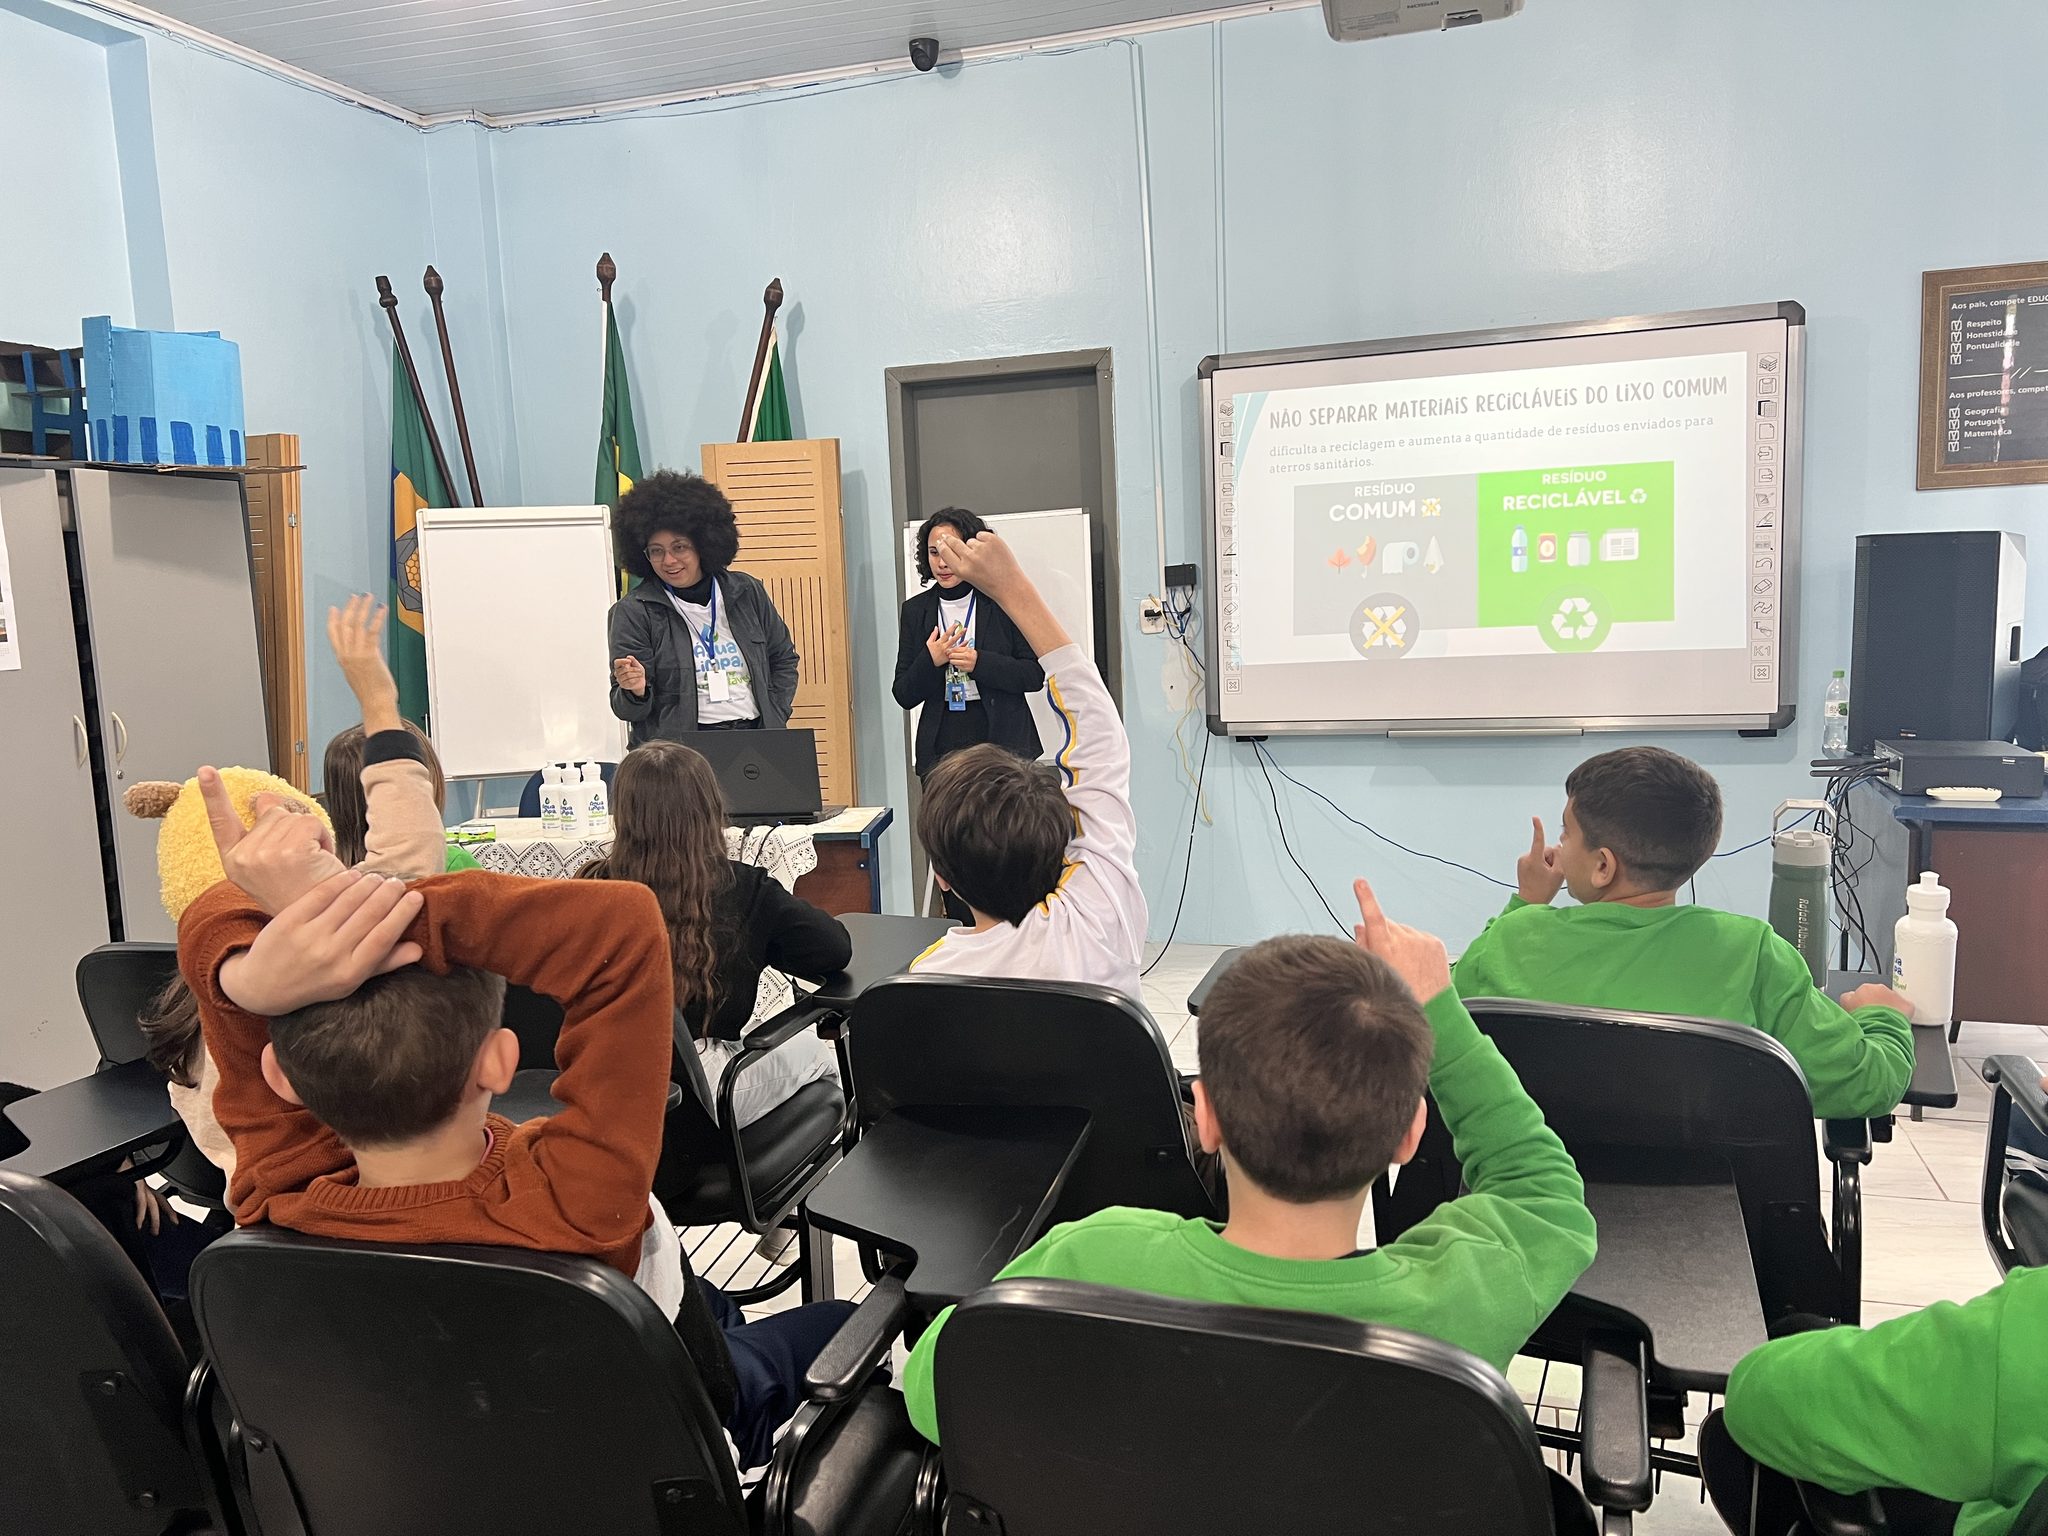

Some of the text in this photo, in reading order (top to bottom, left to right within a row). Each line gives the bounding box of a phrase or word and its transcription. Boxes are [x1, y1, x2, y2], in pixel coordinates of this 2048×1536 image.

[1969, 300, 1988, 309] pais,
[1990, 297, 2025, 306] compete
[1966, 319, 2002, 328] Respeito
[1269, 408, 1302, 429] NÃO
[1308, 403, 1378, 426] SEPARAR
[1585, 385, 1608, 405] DO
[1662, 376, 1728, 399] COMUM
[1964, 418, 2006, 426] Português
[1269, 416, 1714, 457] dificulta a reciclagem e aumenta a quantidade de resíduos enviados para
[1269, 463, 1311, 474] aterros
[1541, 469, 1607, 486] RESÍDUO
[1354, 482, 1416, 498] RESÍDUO
[1503, 487, 1626, 512] RECICLÁVEL
[1328, 500, 1416, 522] COMUM
[693, 642, 737, 658] Áua
[695, 656, 744, 673] impa,
[1797, 898, 1809, 924] Rafael
